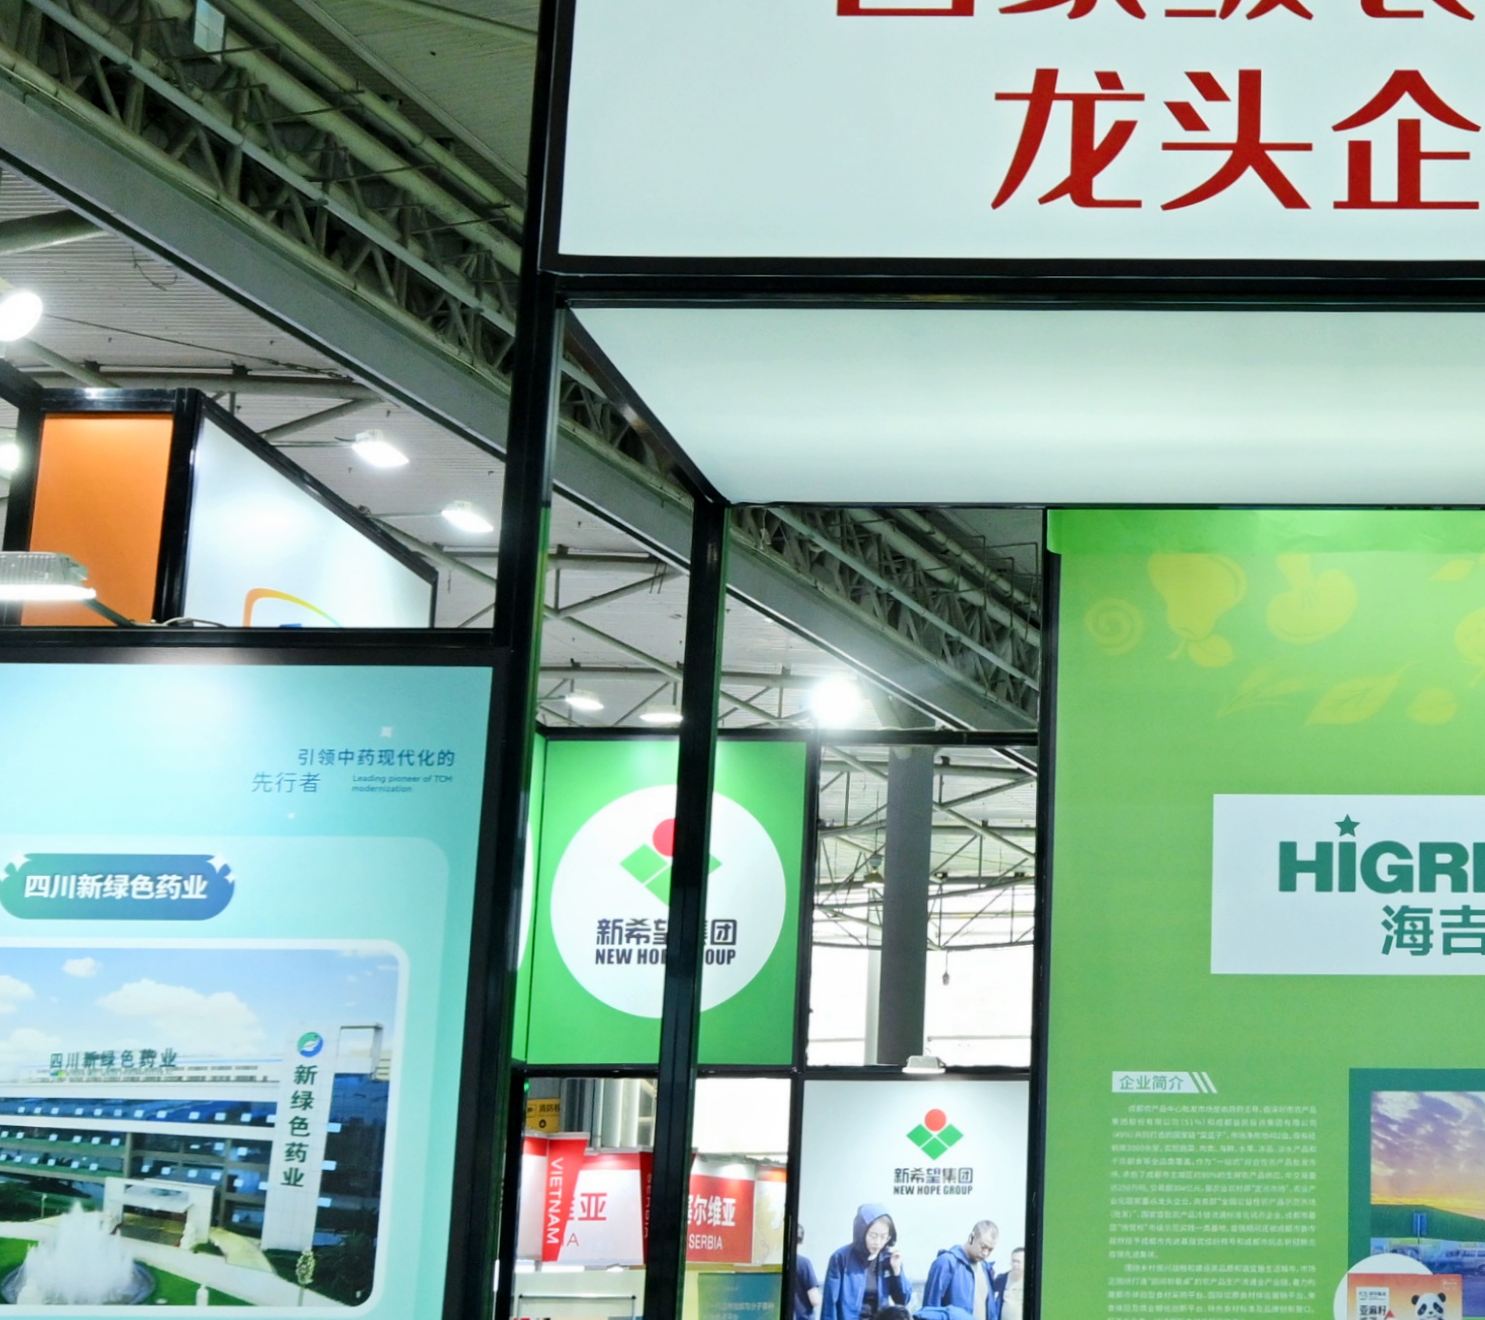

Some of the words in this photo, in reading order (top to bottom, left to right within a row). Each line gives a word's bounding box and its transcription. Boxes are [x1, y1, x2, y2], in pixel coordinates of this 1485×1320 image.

[298, 748, 455, 767] 引领中药现代化的
[251, 772, 321, 793] 先行者
[351, 785, 412, 793] modernization
[24, 874, 208, 901] 四川新绿色药业
[596, 918, 737, 946] 新希望团
[595, 948, 633, 965] NEW
[1119, 1075, 1184, 1090] 企业简介
[281, 1064, 318, 1188] 新绿色药业
[894, 1167, 973, 1184] 新希望集团
[893, 1185, 914, 1195] NEW
[917, 1185, 940, 1195] HOPE
[943, 1185, 973, 1196] GROUP
[546, 1157, 564, 1245] VIETNAM
[689, 1234, 723, 1250] SERBIA
